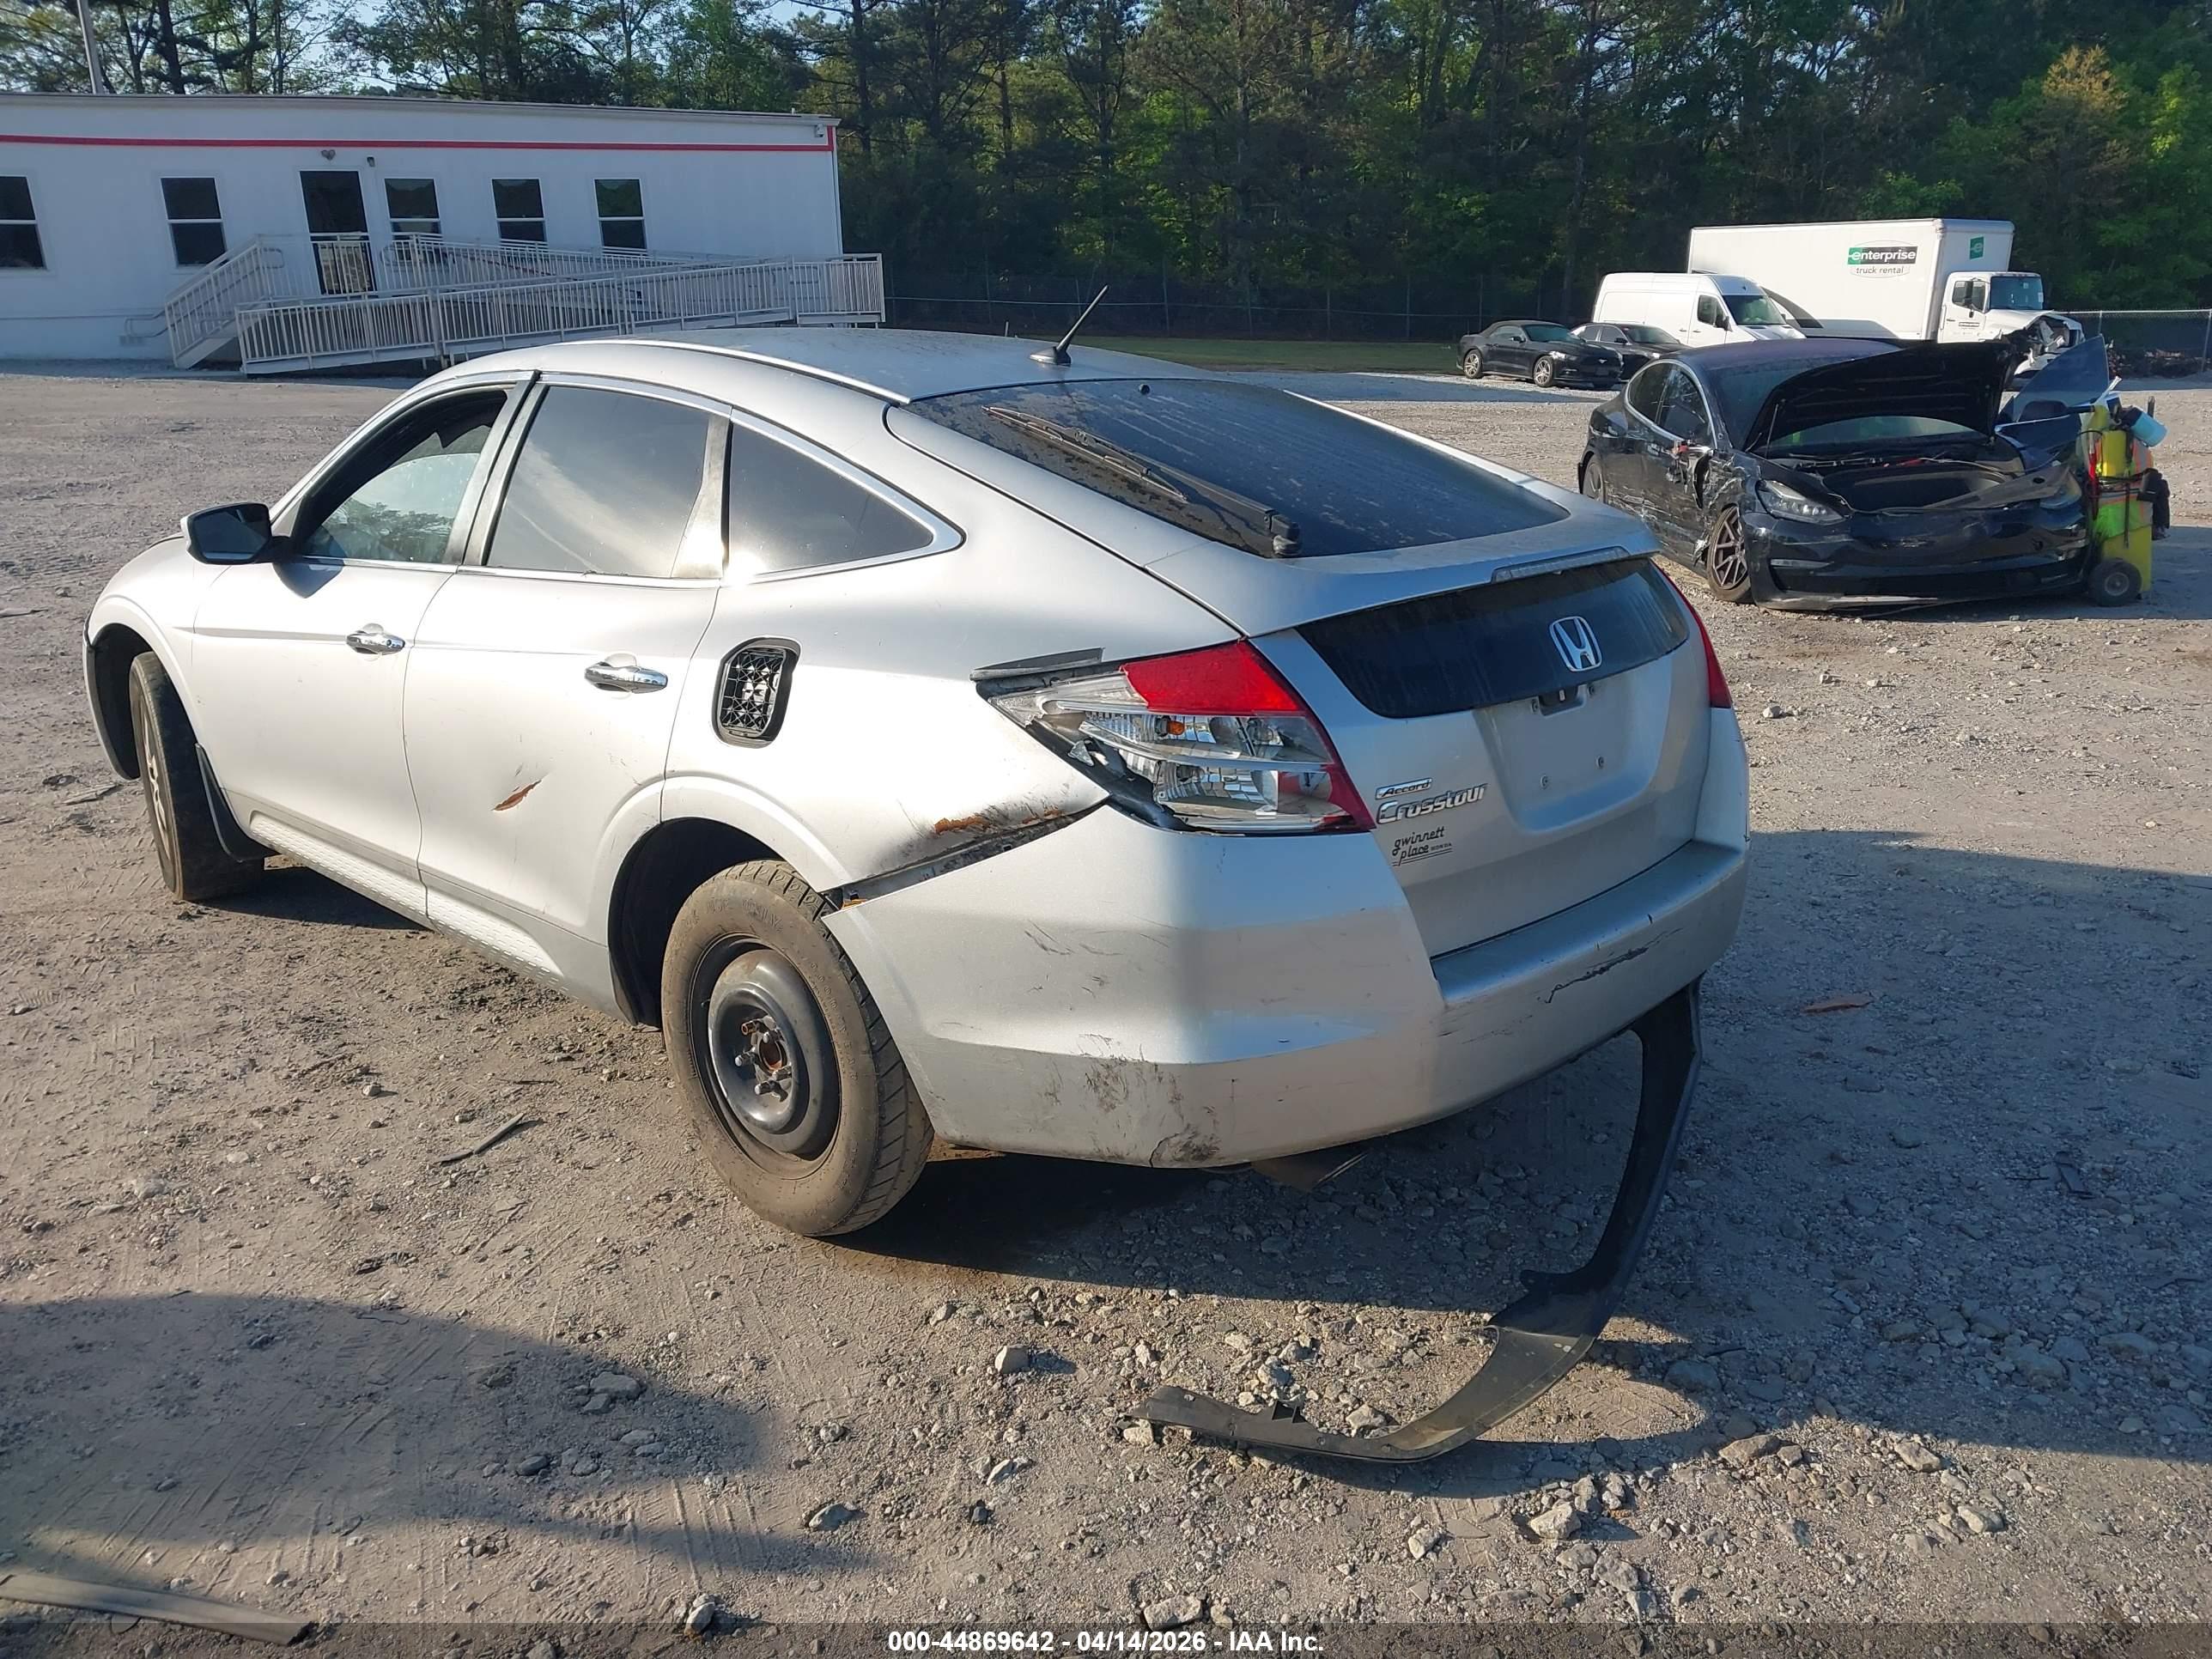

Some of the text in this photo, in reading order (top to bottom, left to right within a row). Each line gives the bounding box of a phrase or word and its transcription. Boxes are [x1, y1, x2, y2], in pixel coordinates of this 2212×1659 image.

[1849, 249, 1917, 264] enterprise
[1381, 779, 1431, 797] Accord
[1376, 783, 1488, 824] Crosstour
[1392, 826, 1444, 856] gwinnett
[1397, 844, 1429, 866] place
